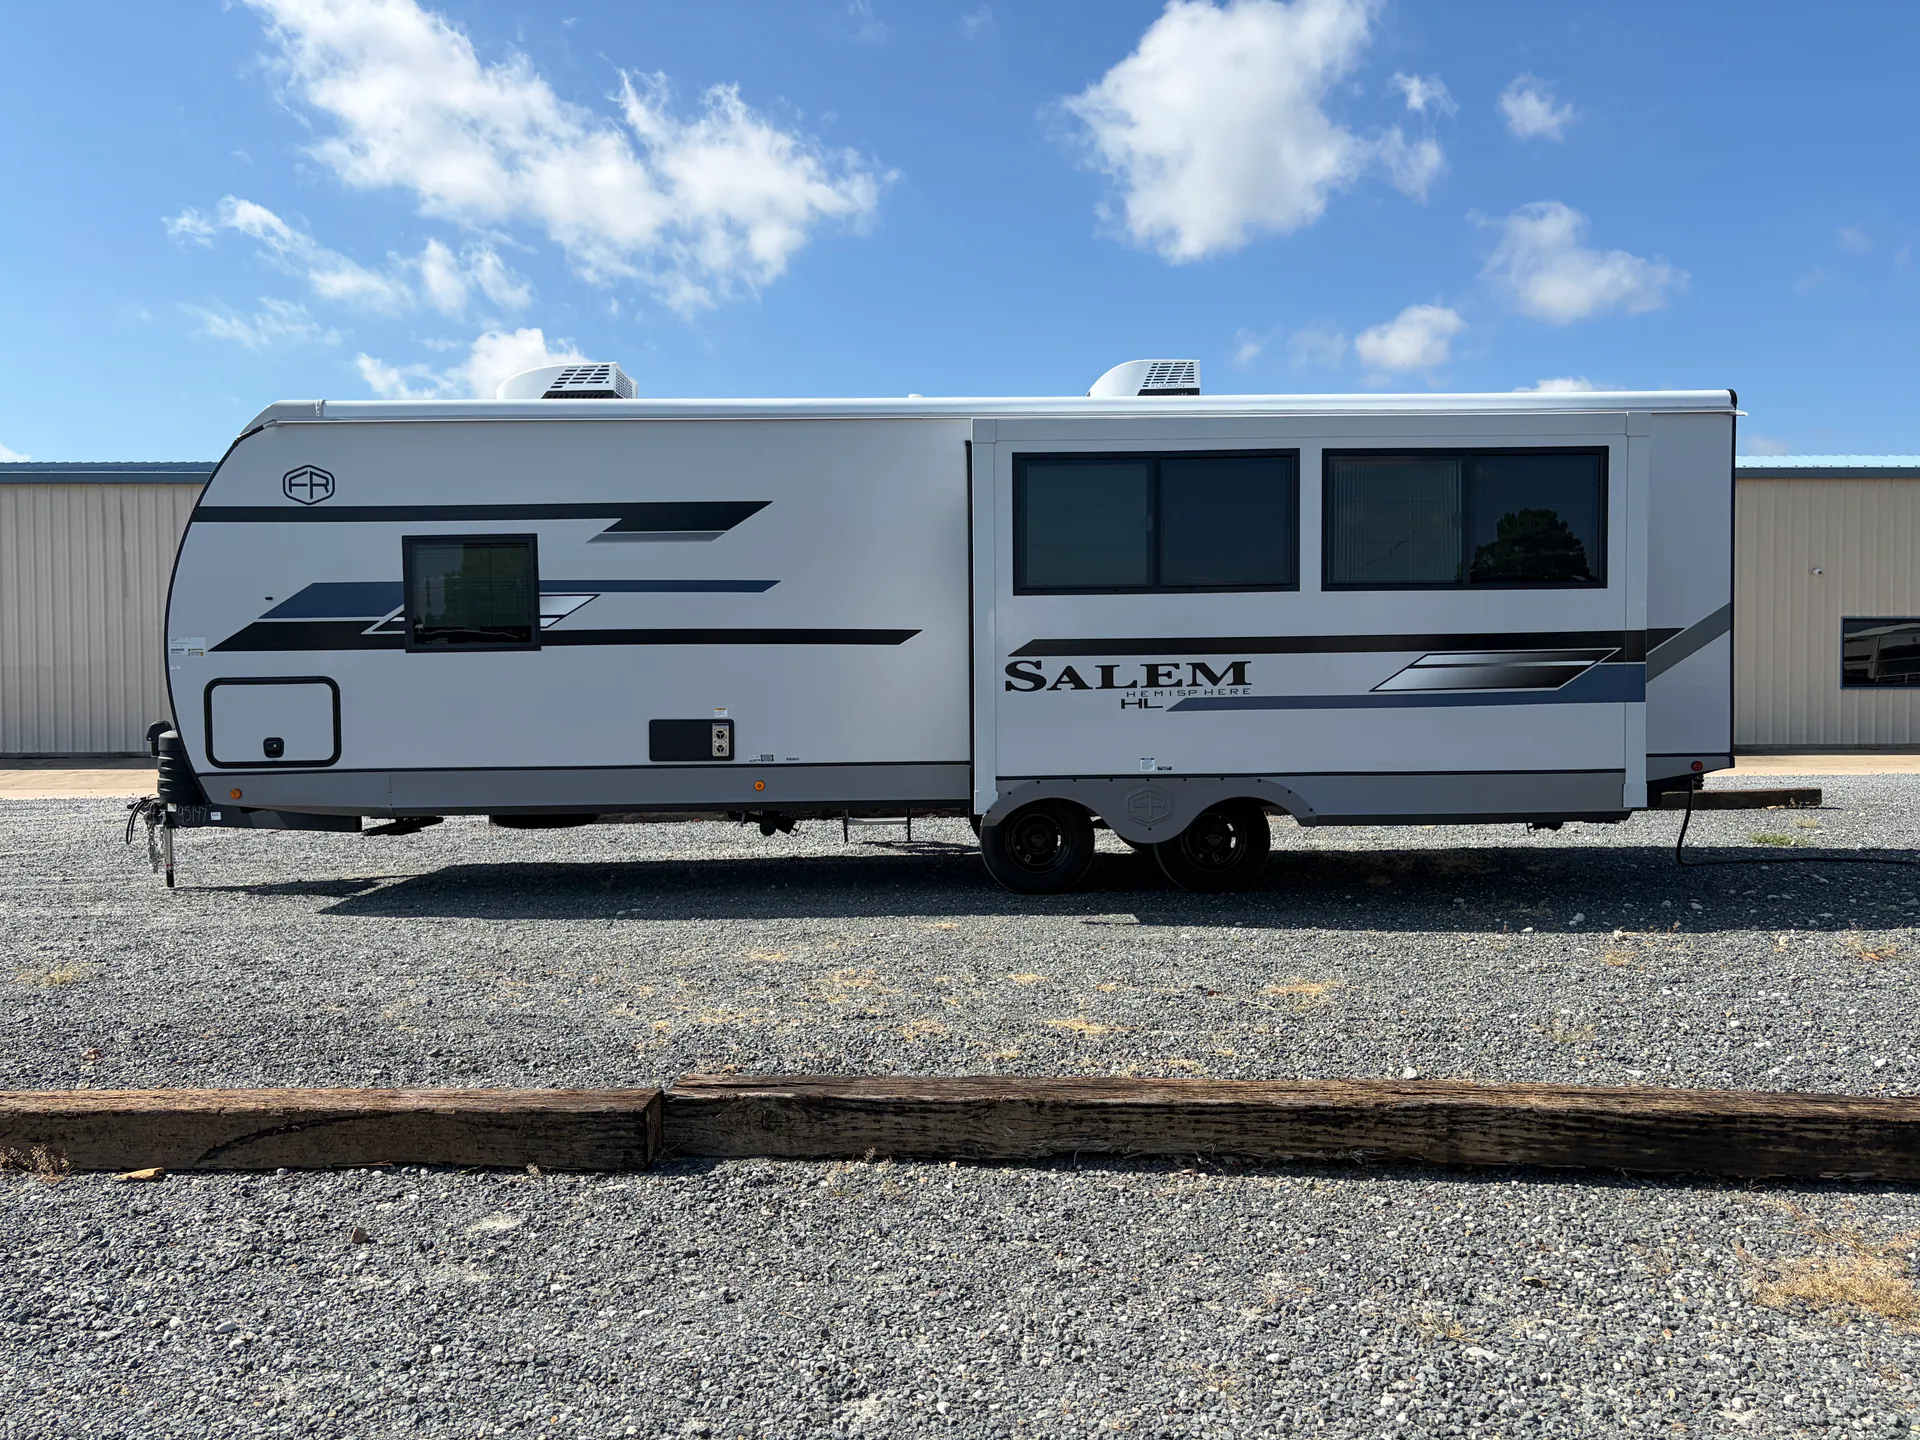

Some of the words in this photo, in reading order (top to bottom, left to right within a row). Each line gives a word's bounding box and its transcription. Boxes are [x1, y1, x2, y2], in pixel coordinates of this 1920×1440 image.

[1005, 660, 1252, 692] SALEM
[1126, 688, 1251, 697] HEMISPHERE
[1121, 698, 1163, 709] HL
[178, 805, 207, 823] 95147
